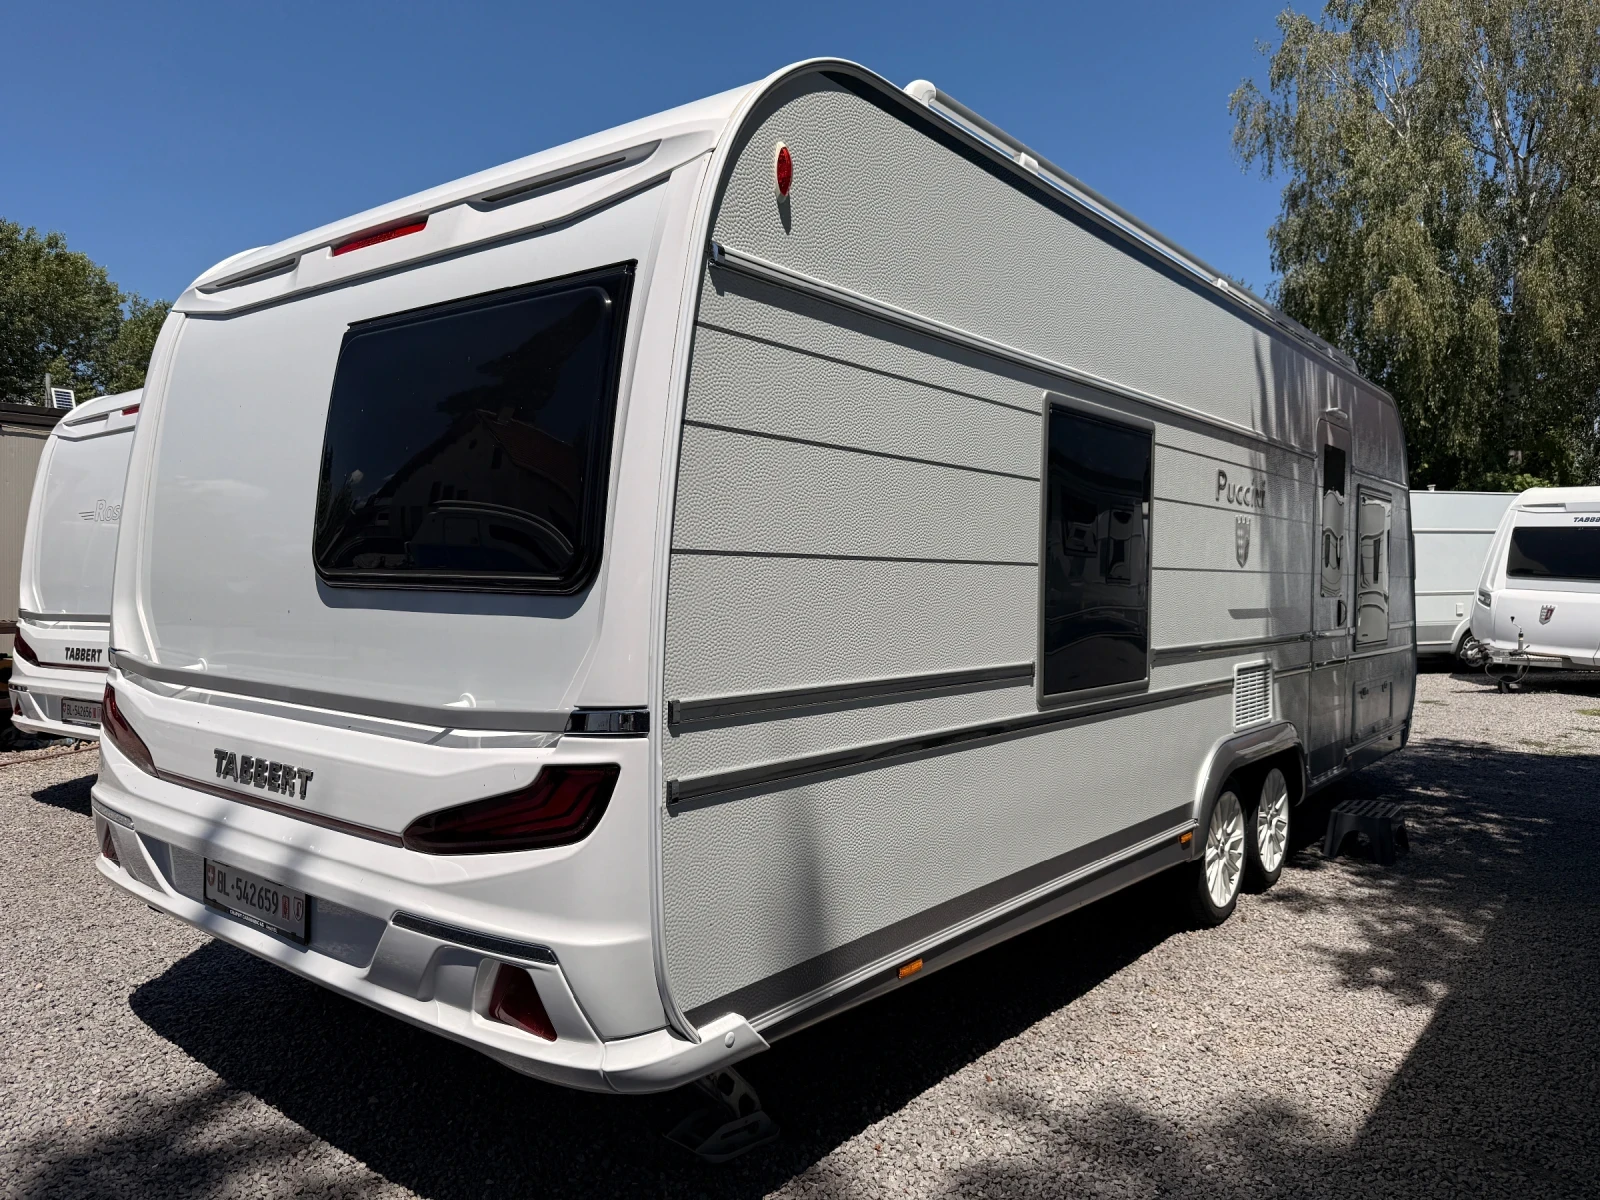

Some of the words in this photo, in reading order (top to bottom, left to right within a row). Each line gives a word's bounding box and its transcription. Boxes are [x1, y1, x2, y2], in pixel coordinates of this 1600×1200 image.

[1215, 469, 1266, 508] Puccini
[65, 646, 103, 663] TABBERT
[213, 747, 314, 800] TABBERT
